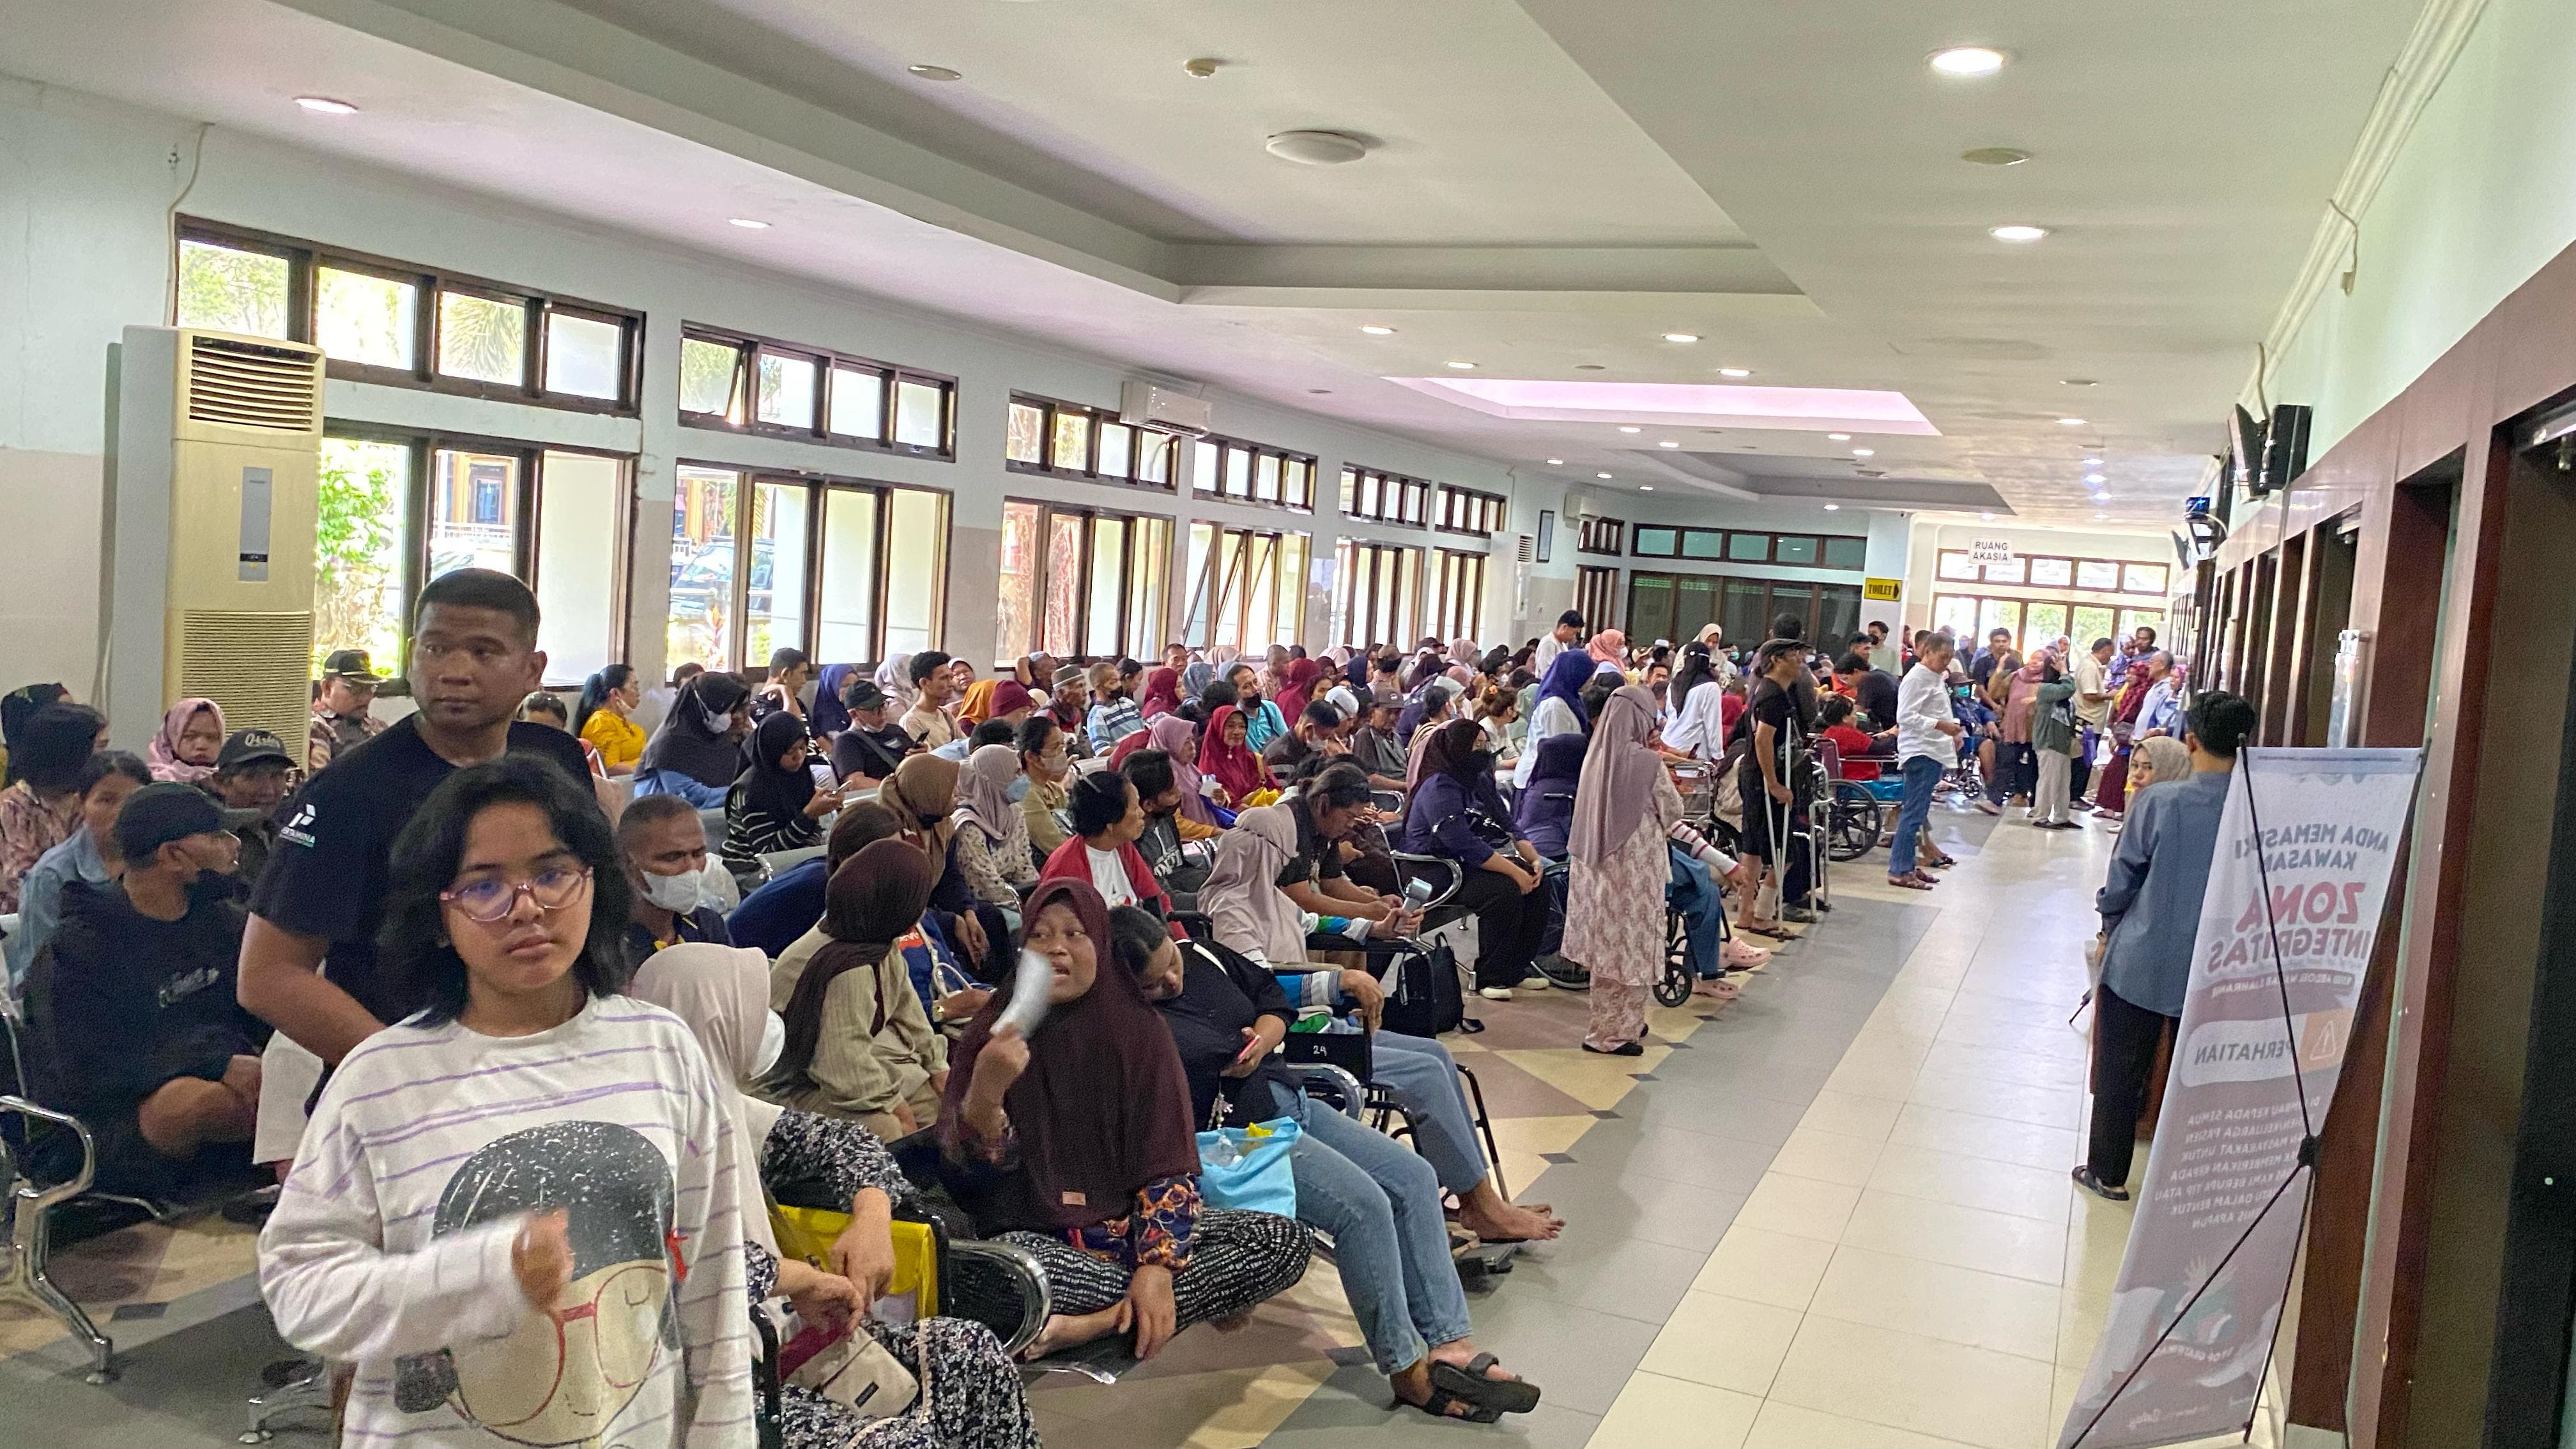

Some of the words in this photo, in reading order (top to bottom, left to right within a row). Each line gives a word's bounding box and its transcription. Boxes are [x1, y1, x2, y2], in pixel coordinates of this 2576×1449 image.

[1975, 541, 2008, 551] RUANG
[1973, 551, 2007, 561] AKASIA
[1868, 584, 1892, 595] TOILET
